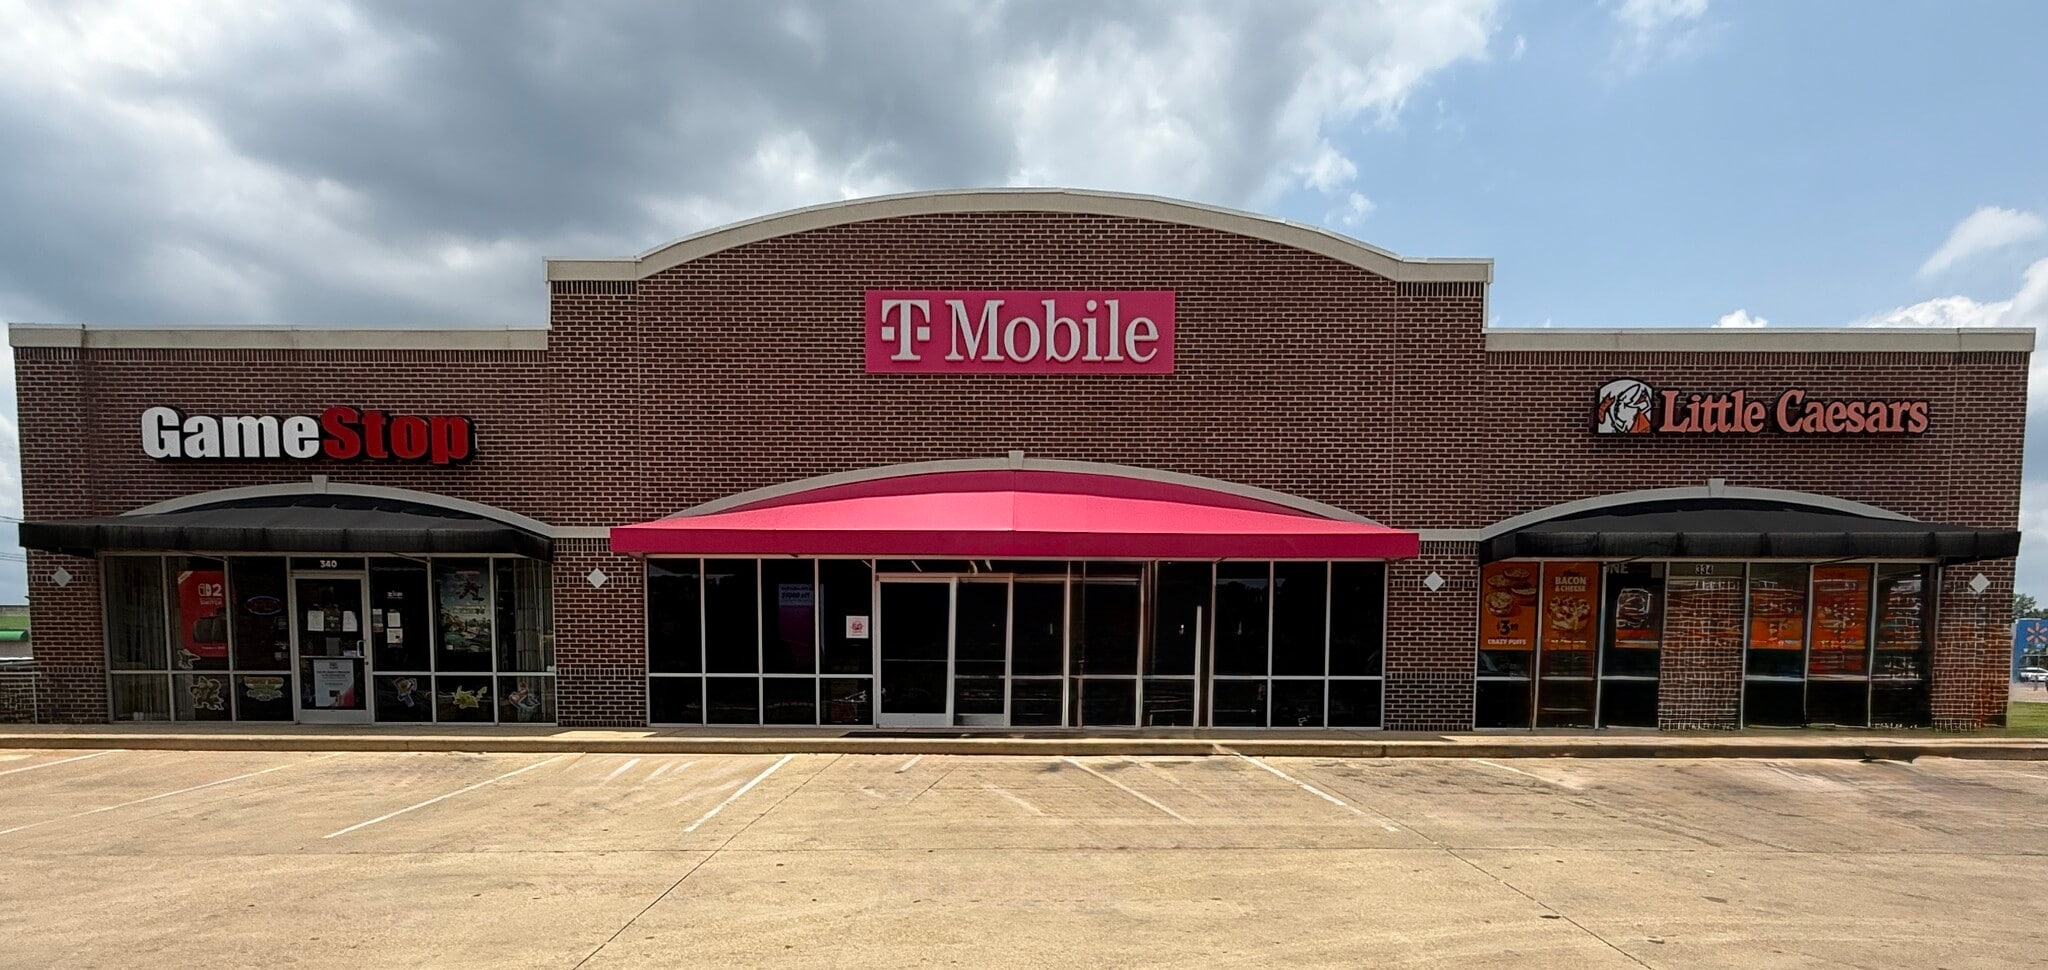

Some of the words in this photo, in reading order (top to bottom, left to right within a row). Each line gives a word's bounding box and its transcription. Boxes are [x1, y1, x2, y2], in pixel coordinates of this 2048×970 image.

[881, 299, 930, 361] T
[945, 299, 1159, 363] Mobile
[1659, 389, 1766, 433] Little
[1776, 389, 1930, 433] Caesars
[141, 406, 470, 464] GameStop
[319, 560, 338, 568] 340
[1695, 564, 1714, 575] 334
[1555, 576, 1587, 585] BACON
[212, 583, 222, 596] 2
